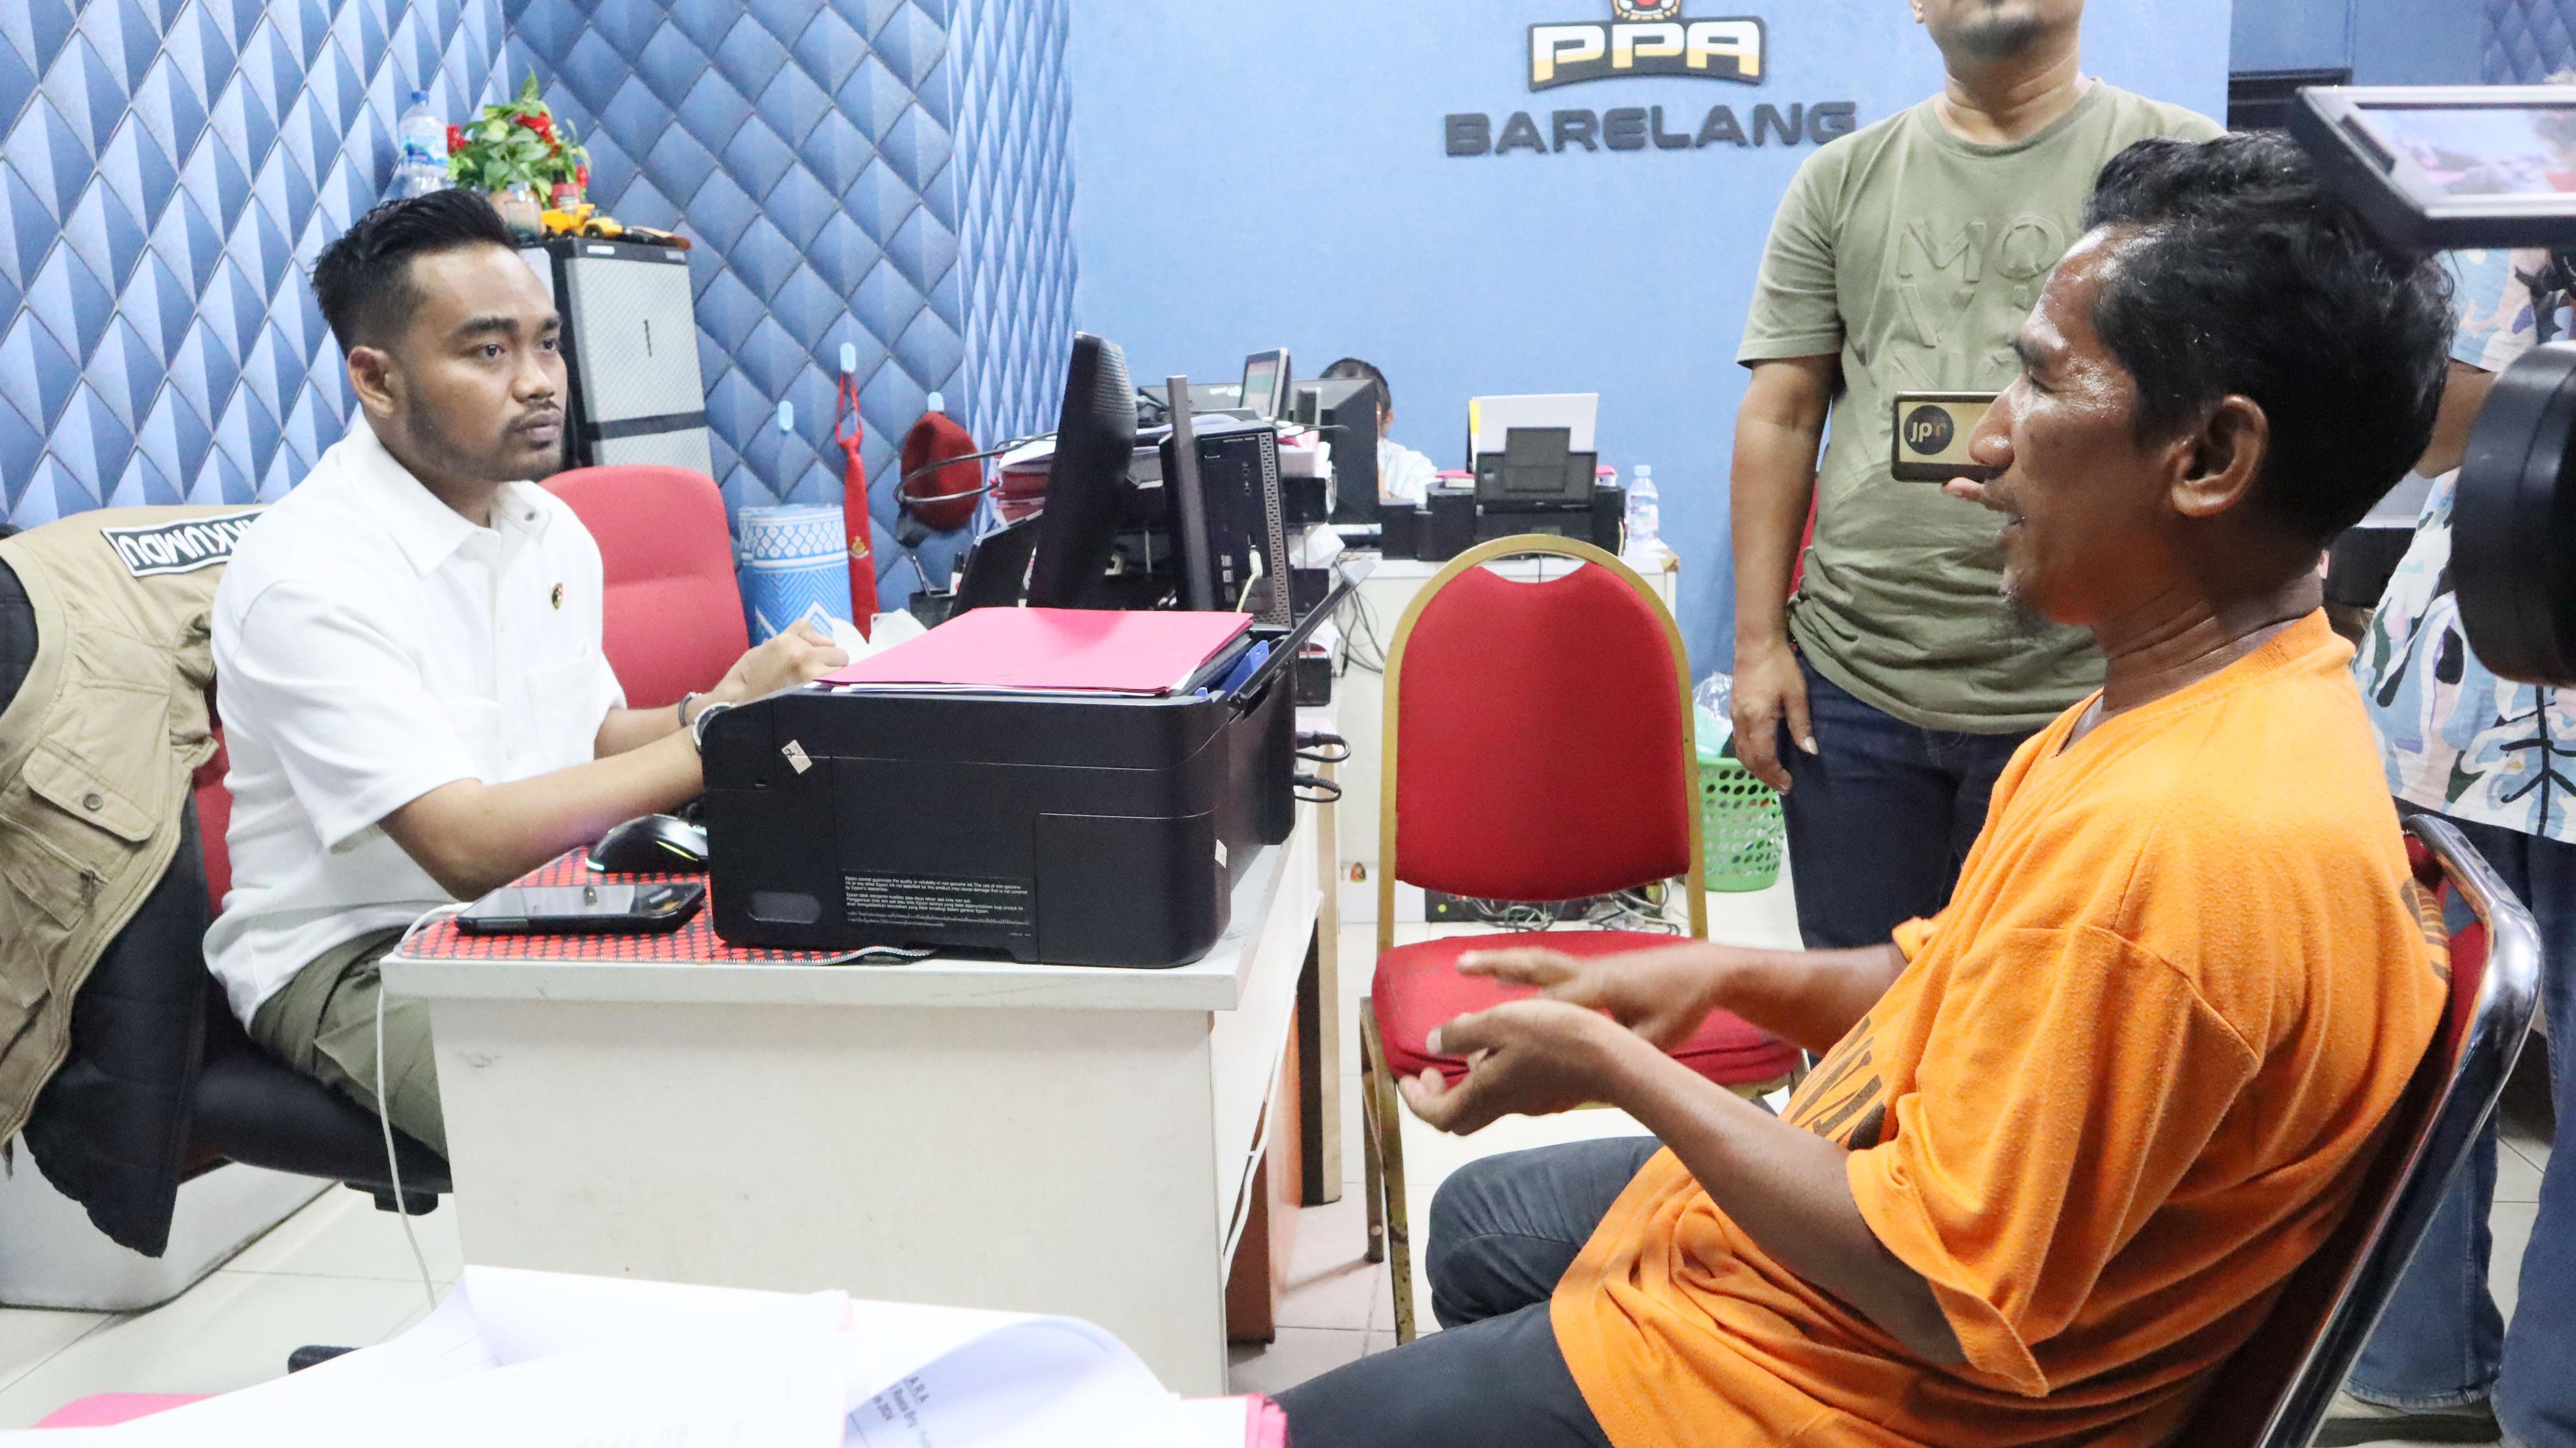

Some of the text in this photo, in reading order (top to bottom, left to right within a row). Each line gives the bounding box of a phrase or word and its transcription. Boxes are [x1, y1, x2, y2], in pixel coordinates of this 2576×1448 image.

[1532, 21, 1761, 82] PPA
[1444, 101, 1857, 157] BARELANG
[117, 518, 250, 567] KUMDU
